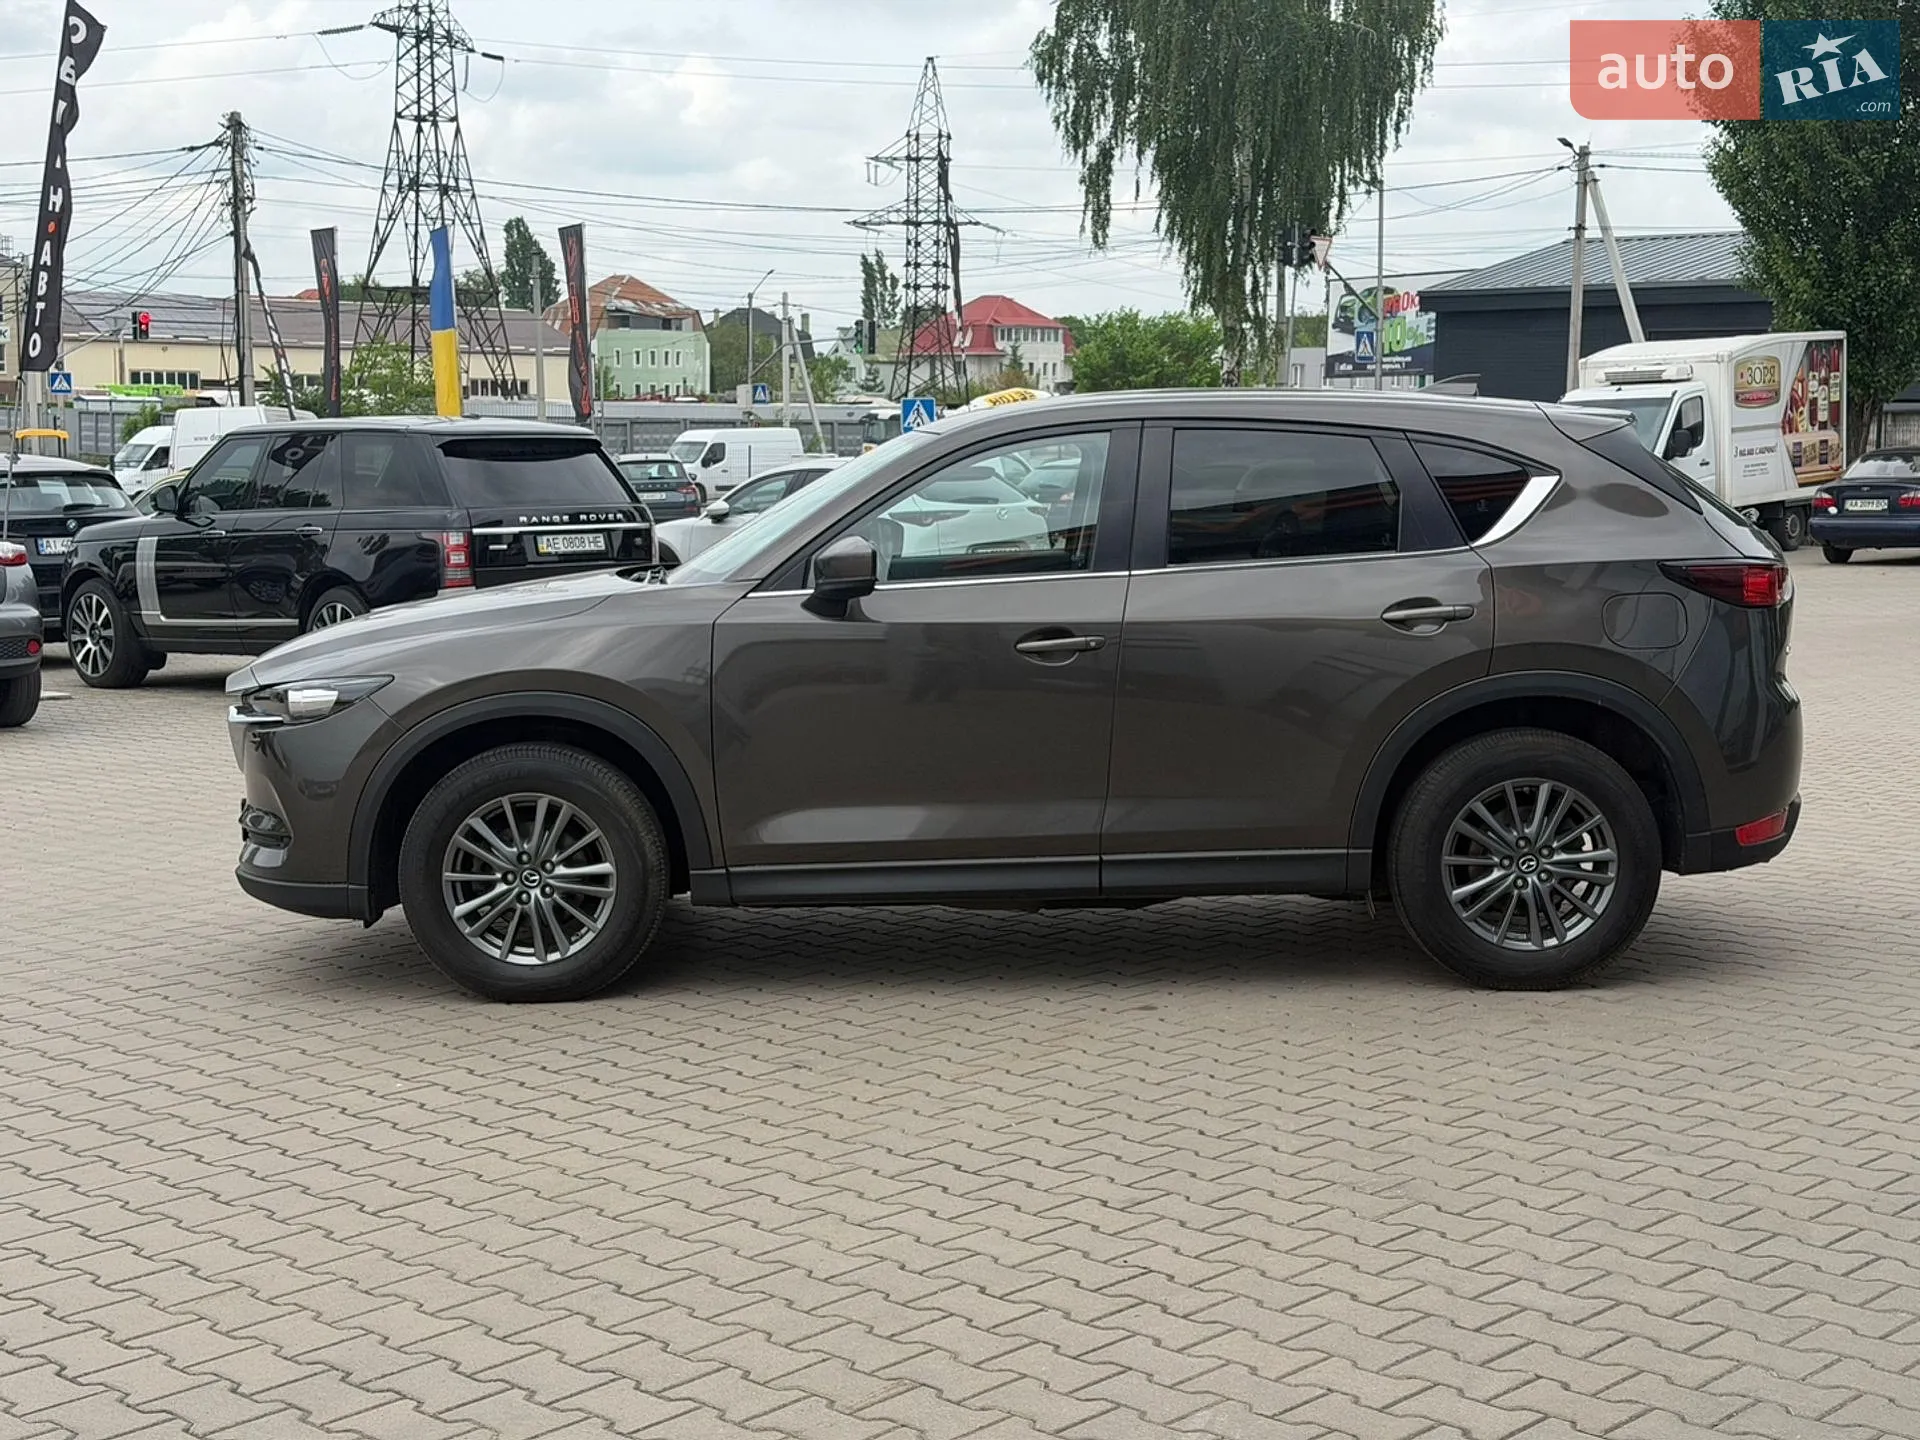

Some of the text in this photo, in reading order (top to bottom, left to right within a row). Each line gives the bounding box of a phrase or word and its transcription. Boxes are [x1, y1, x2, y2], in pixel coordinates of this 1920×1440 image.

[29, 240, 51, 358] АВТО
[1746, 365, 1776, 385] ЗОРЯ
[519, 513, 624, 523] RANGE ROVER
[546, 535, 603, 550] AE 0808 HE
